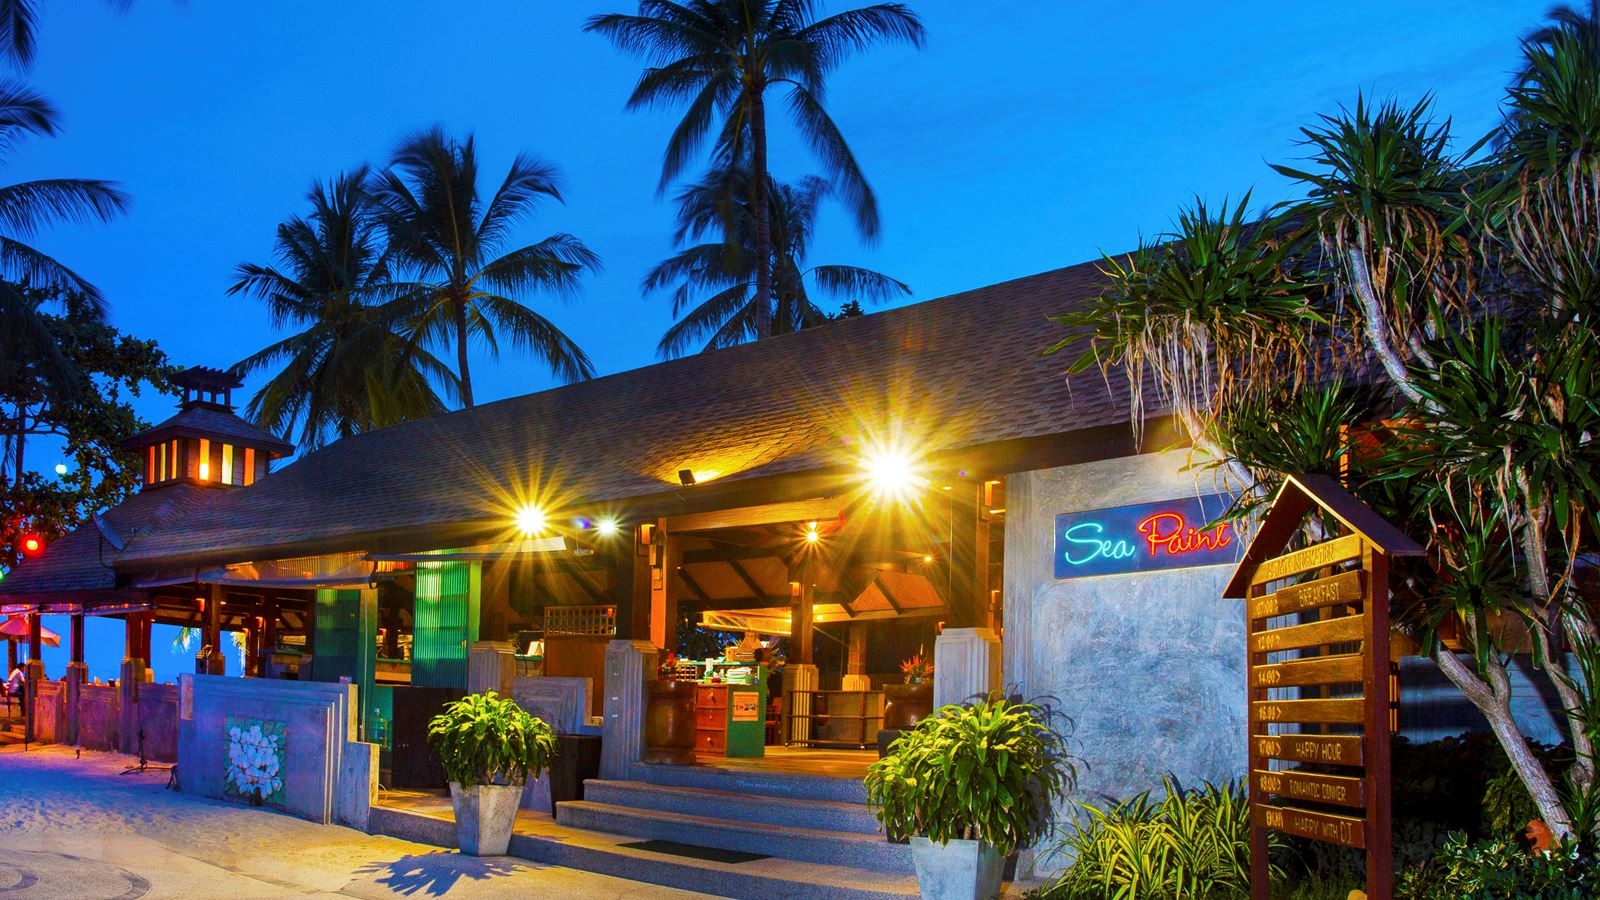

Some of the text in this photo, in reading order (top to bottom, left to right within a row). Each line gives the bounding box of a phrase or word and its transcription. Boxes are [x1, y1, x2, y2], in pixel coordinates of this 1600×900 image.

[1065, 512, 1232, 565] Sea Paint
[1299, 582, 1339, 607] BREAKFAST
[1296, 741, 1342, 760] HAPPY HOUR
[1290, 780, 1346, 801] ROMANTIC DINNER
[1295, 816, 1319, 835] HAPPY
[1322, 822, 1338, 840] WITH
